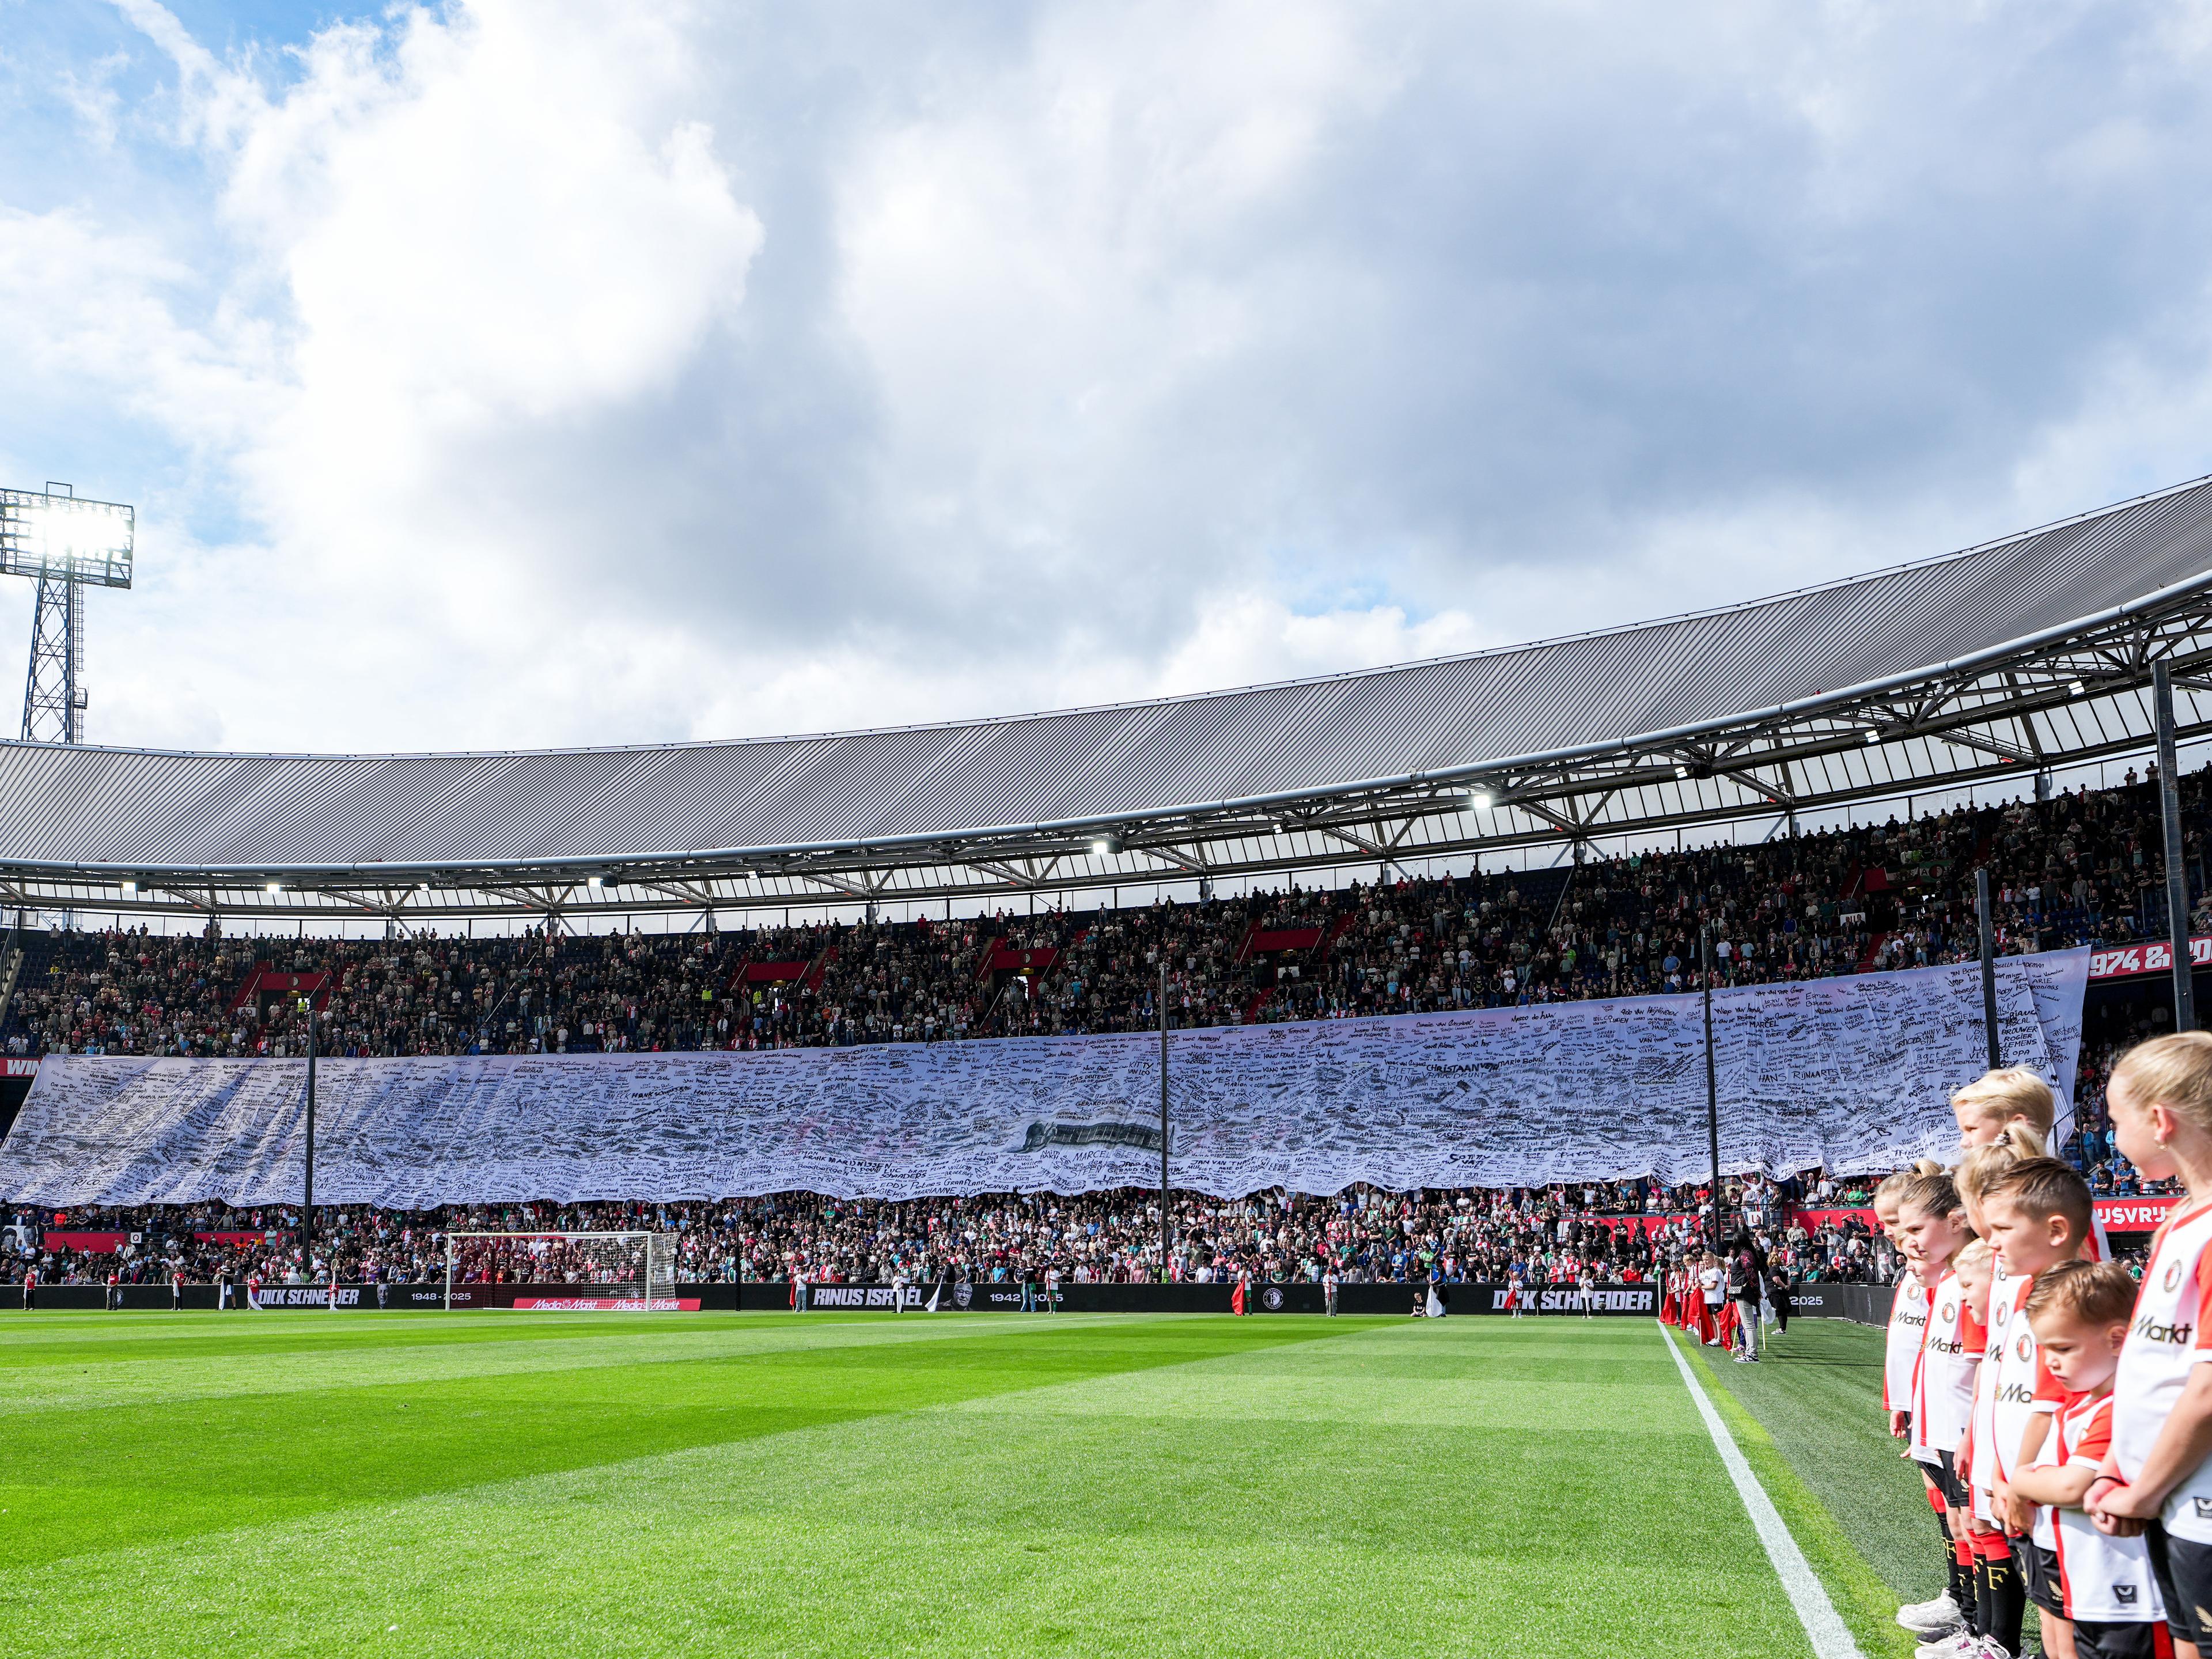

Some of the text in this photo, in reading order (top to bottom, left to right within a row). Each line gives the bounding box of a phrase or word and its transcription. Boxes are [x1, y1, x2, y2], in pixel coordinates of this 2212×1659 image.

[258, 1289, 359, 1305] DICK SCHNEDER
[412, 1293, 437, 1301] 1948
[532, 1299, 562, 1309] Media
[569, 1299, 598, 1309] Markt
[813, 1289, 864, 1306] RINUS
[990, 1293, 1021, 1302] 1942
[1492, 1290, 1539, 1309] DK
[1789, 1296, 1823, 1305] 2025
[2133, 1314, 2192, 1343] Markt
[1927, 1336, 1963, 1354] Markt
[1987, 1566, 2009, 1590] F
